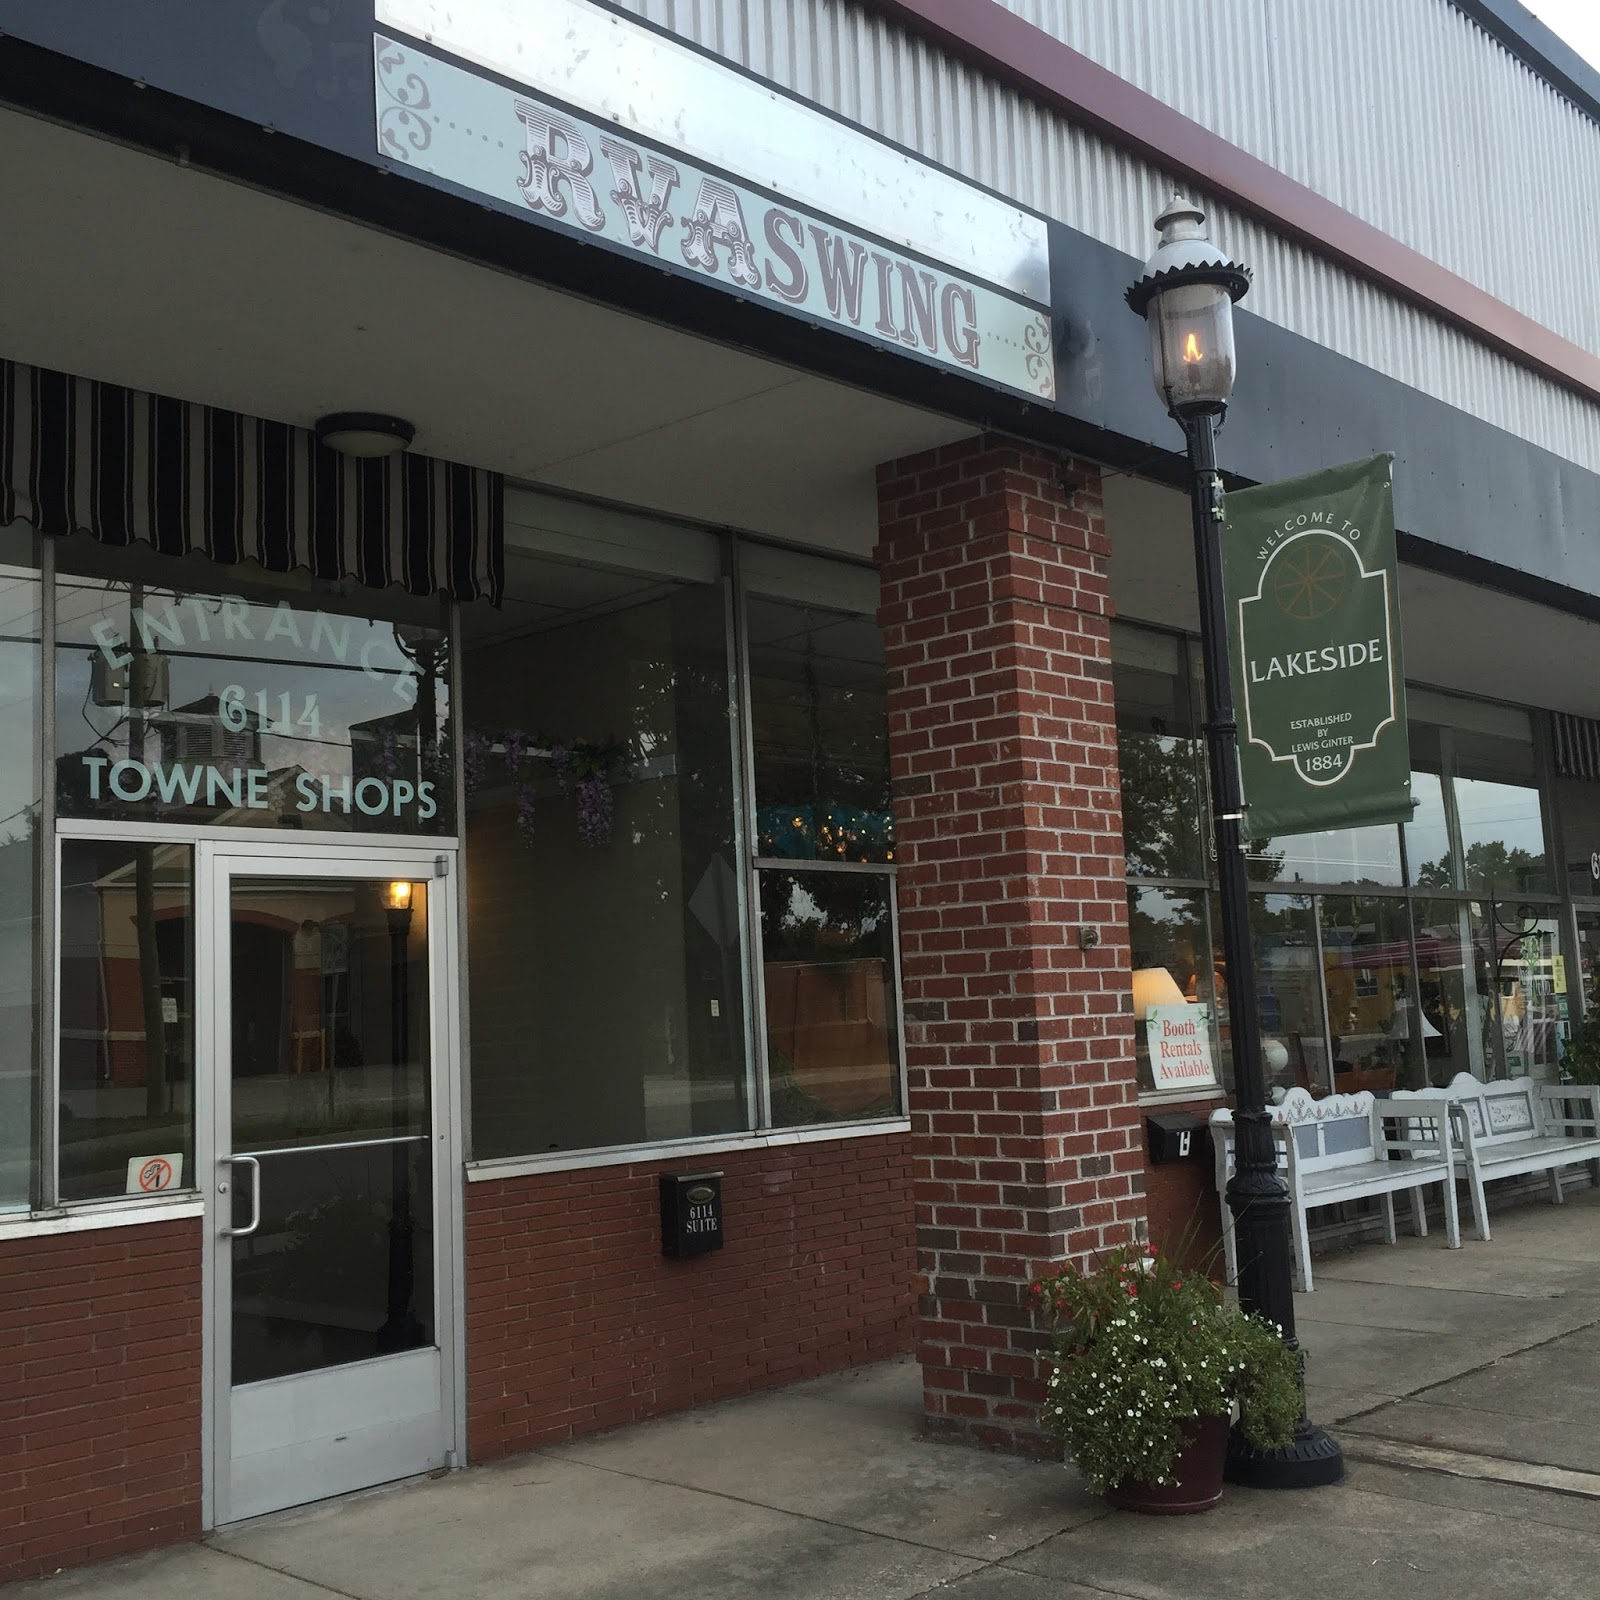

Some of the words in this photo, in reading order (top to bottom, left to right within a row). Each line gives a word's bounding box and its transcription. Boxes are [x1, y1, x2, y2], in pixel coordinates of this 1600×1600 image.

[1257, 511, 1334, 561] WELCOME
[1340, 519, 1361, 542] TO
[89, 592, 426, 705] ENTRANCE
[1250, 638, 1383, 683] LAKESIDE
[218, 684, 324, 739] 6114
[1290, 712, 1352, 730] ESTABLISHED
[1317, 728, 1328, 738] BY
[1291, 740, 1320, 753] LEWIS
[1321, 735, 1354, 749] GINTER
[1305, 753, 1343, 772] 1884
[82, 756, 270, 809] TOWNE
[295, 772, 437, 819] SHOPS
[1162, 1019, 1196, 1037] Booth
[1160, 1039, 1202, 1058] Rentals
[1160, 1059, 1210, 1080] Available
[689, 1204, 713, 1219] 6114
[686, 1218, 718, 1233] SUITE
